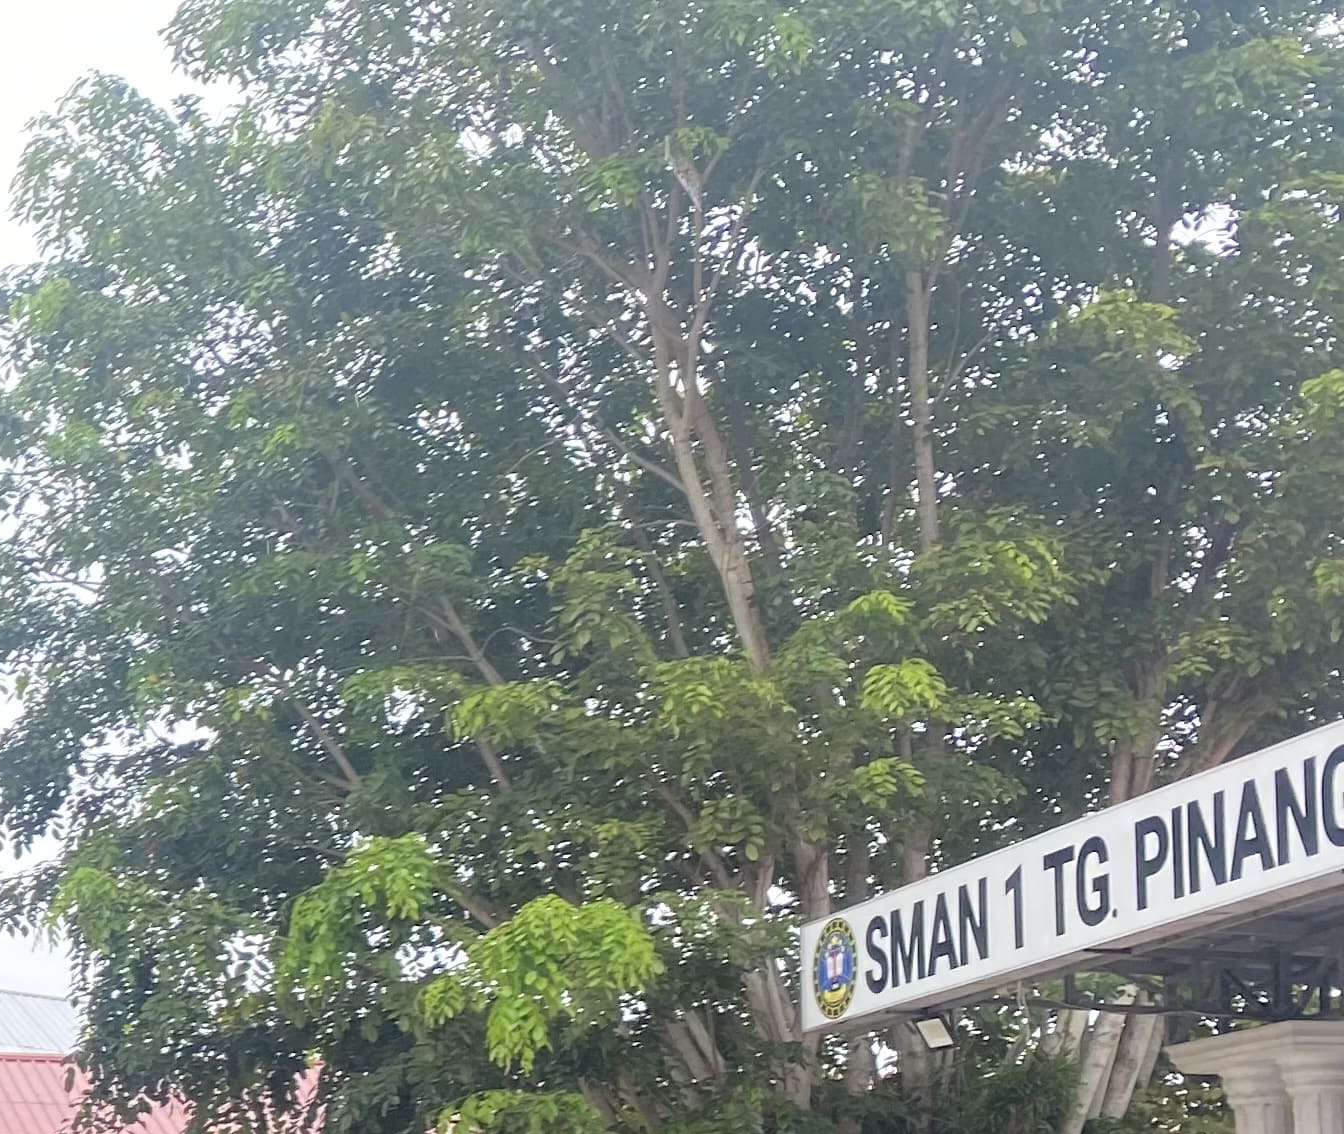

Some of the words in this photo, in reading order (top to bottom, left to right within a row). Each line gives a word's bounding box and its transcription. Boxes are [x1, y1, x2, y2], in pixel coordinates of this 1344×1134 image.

[865, 876, 989, 994] SMAN
[1005, 864, 1025, 950] 1
[1043, 835, 1118, 936] TG.
